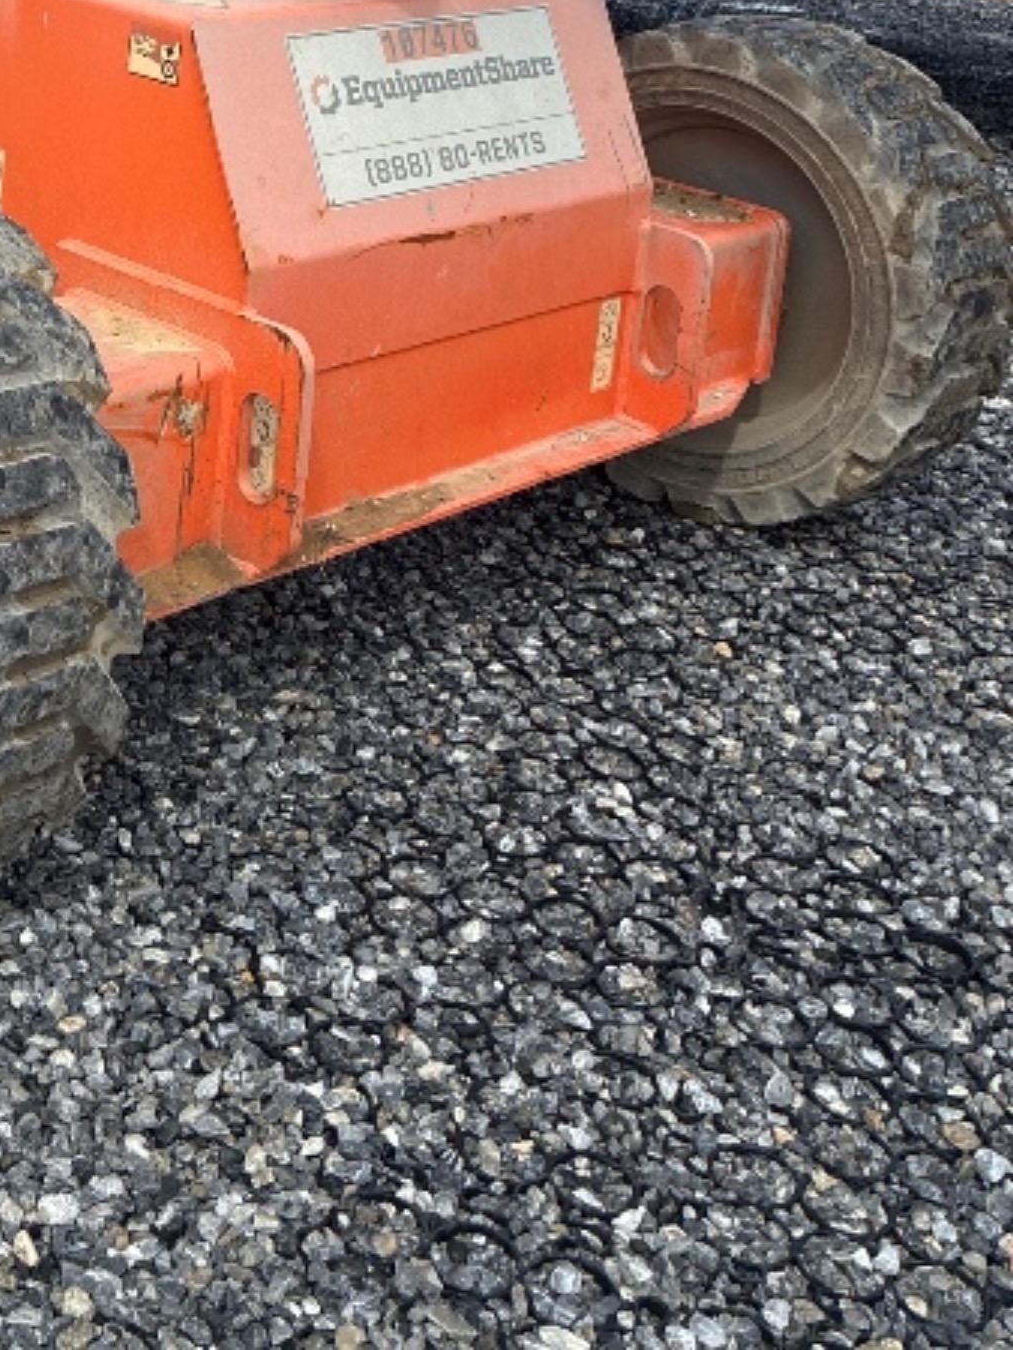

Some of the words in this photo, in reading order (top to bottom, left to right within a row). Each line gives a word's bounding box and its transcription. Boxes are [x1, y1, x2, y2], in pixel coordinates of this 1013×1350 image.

[341, 55, 556, 108] EquipmentShare
[364, 149, 432, 187] (888)
[439, 131, 547, 173] 80-RENTS
